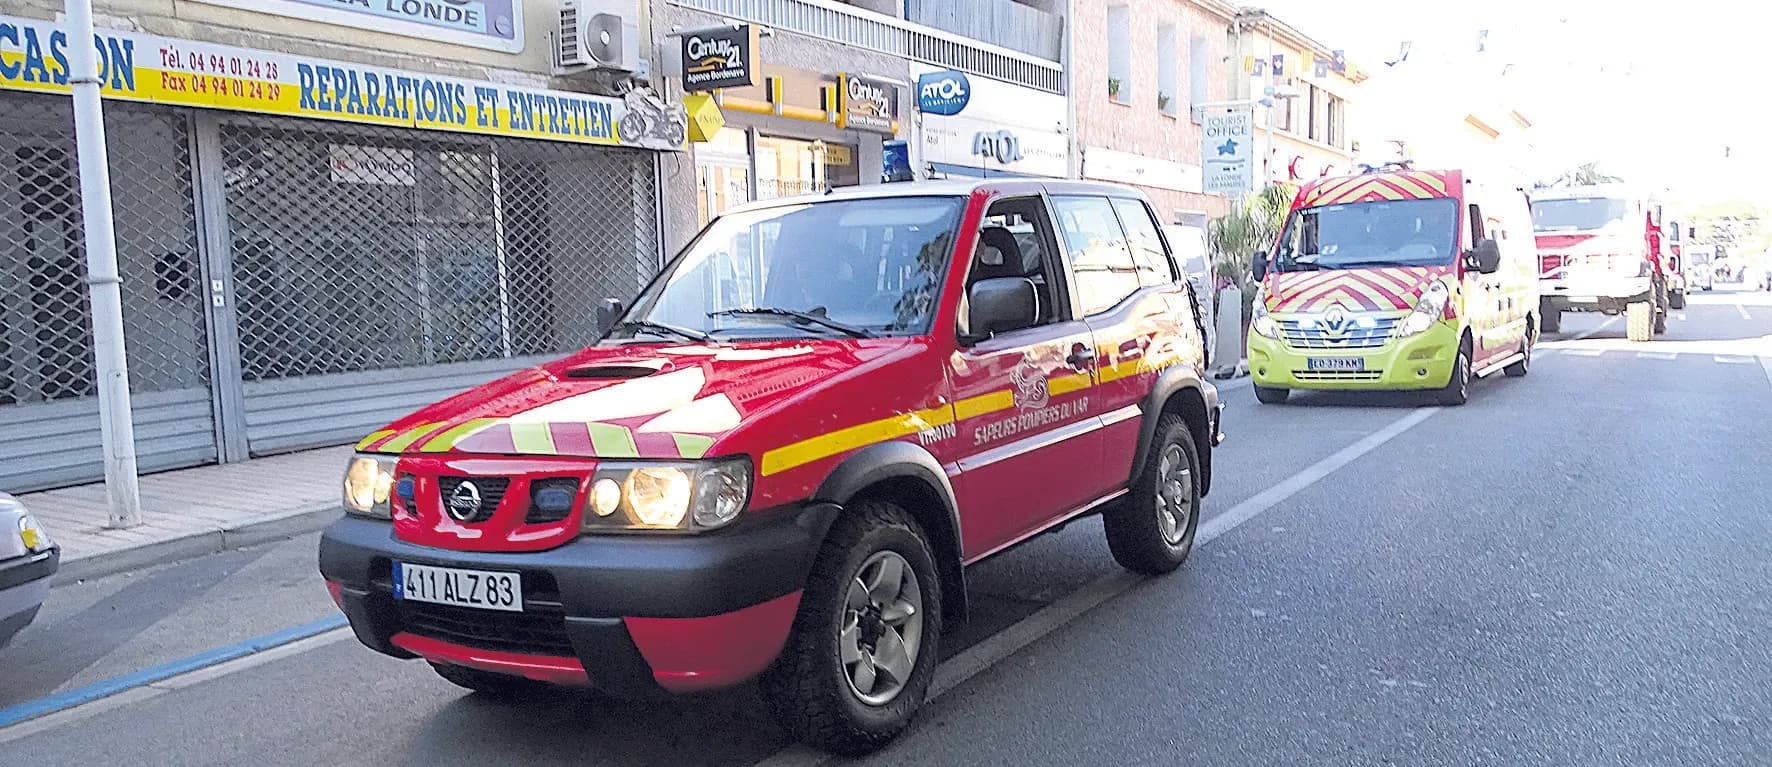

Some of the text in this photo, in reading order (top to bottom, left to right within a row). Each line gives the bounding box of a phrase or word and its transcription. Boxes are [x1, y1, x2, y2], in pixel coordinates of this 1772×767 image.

[387, 0, 479, 27] LONDE
[0, 23, 135, 91] CASON
[159, 45, 279, 80] Tél. 04 94 01 24 28
[687, 36, 731, 60] Century
[161, 71, 281, 101] Fax 04 94 01 24 29
[297, 63, 613, 139] REPARATIONS ET ENTRETIEN
[921, 79, 965, 99] ATOL
[1207, 115, 1247, 126] TOURIST
[1207, 125, 1248, 138] OFFICE
[972, 130, 1024, 164] ATOL
[974, 417, 1017, 446] SAPEURS
[1017, 406, 1060, 432] POMPIERS
[1060, 402, 1073, 419] DU
[406, 568, 514, 606] 411 ALZ 83
